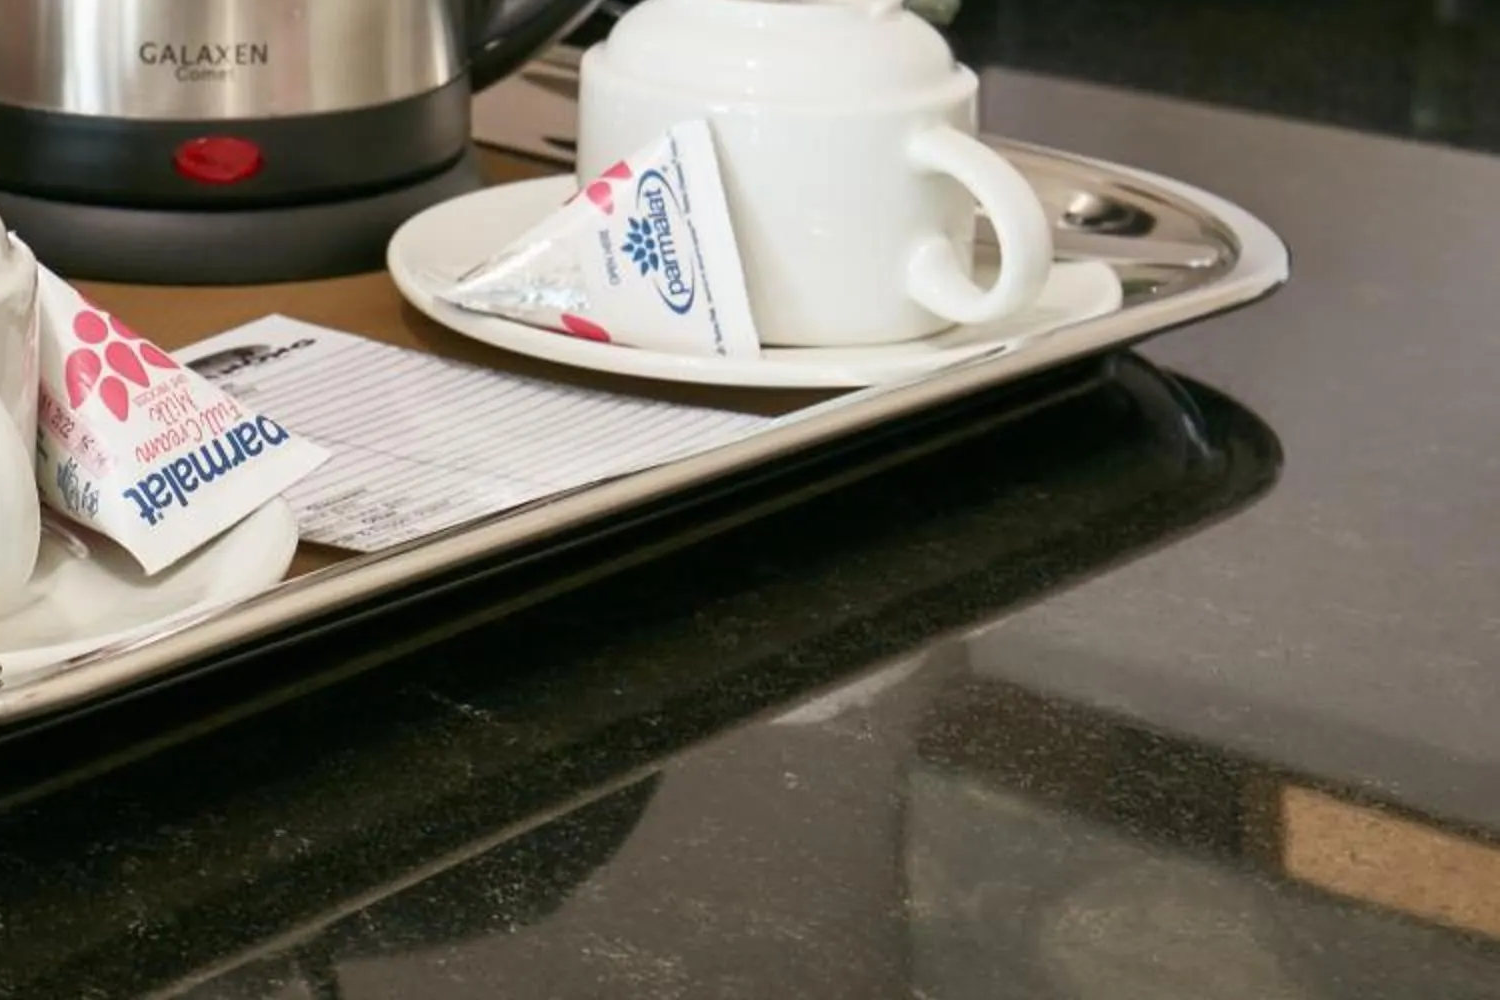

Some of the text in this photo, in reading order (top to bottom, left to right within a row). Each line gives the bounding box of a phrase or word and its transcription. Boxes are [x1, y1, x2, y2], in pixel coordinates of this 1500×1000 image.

[139, 41, 269, 66] GALAXEN
[644, 187, 692, 296] parmalat
[149, 389, 199, 426] Milk
[134, 417, 203, 463] Cream
[122, 414, 290, 526] parmalat
